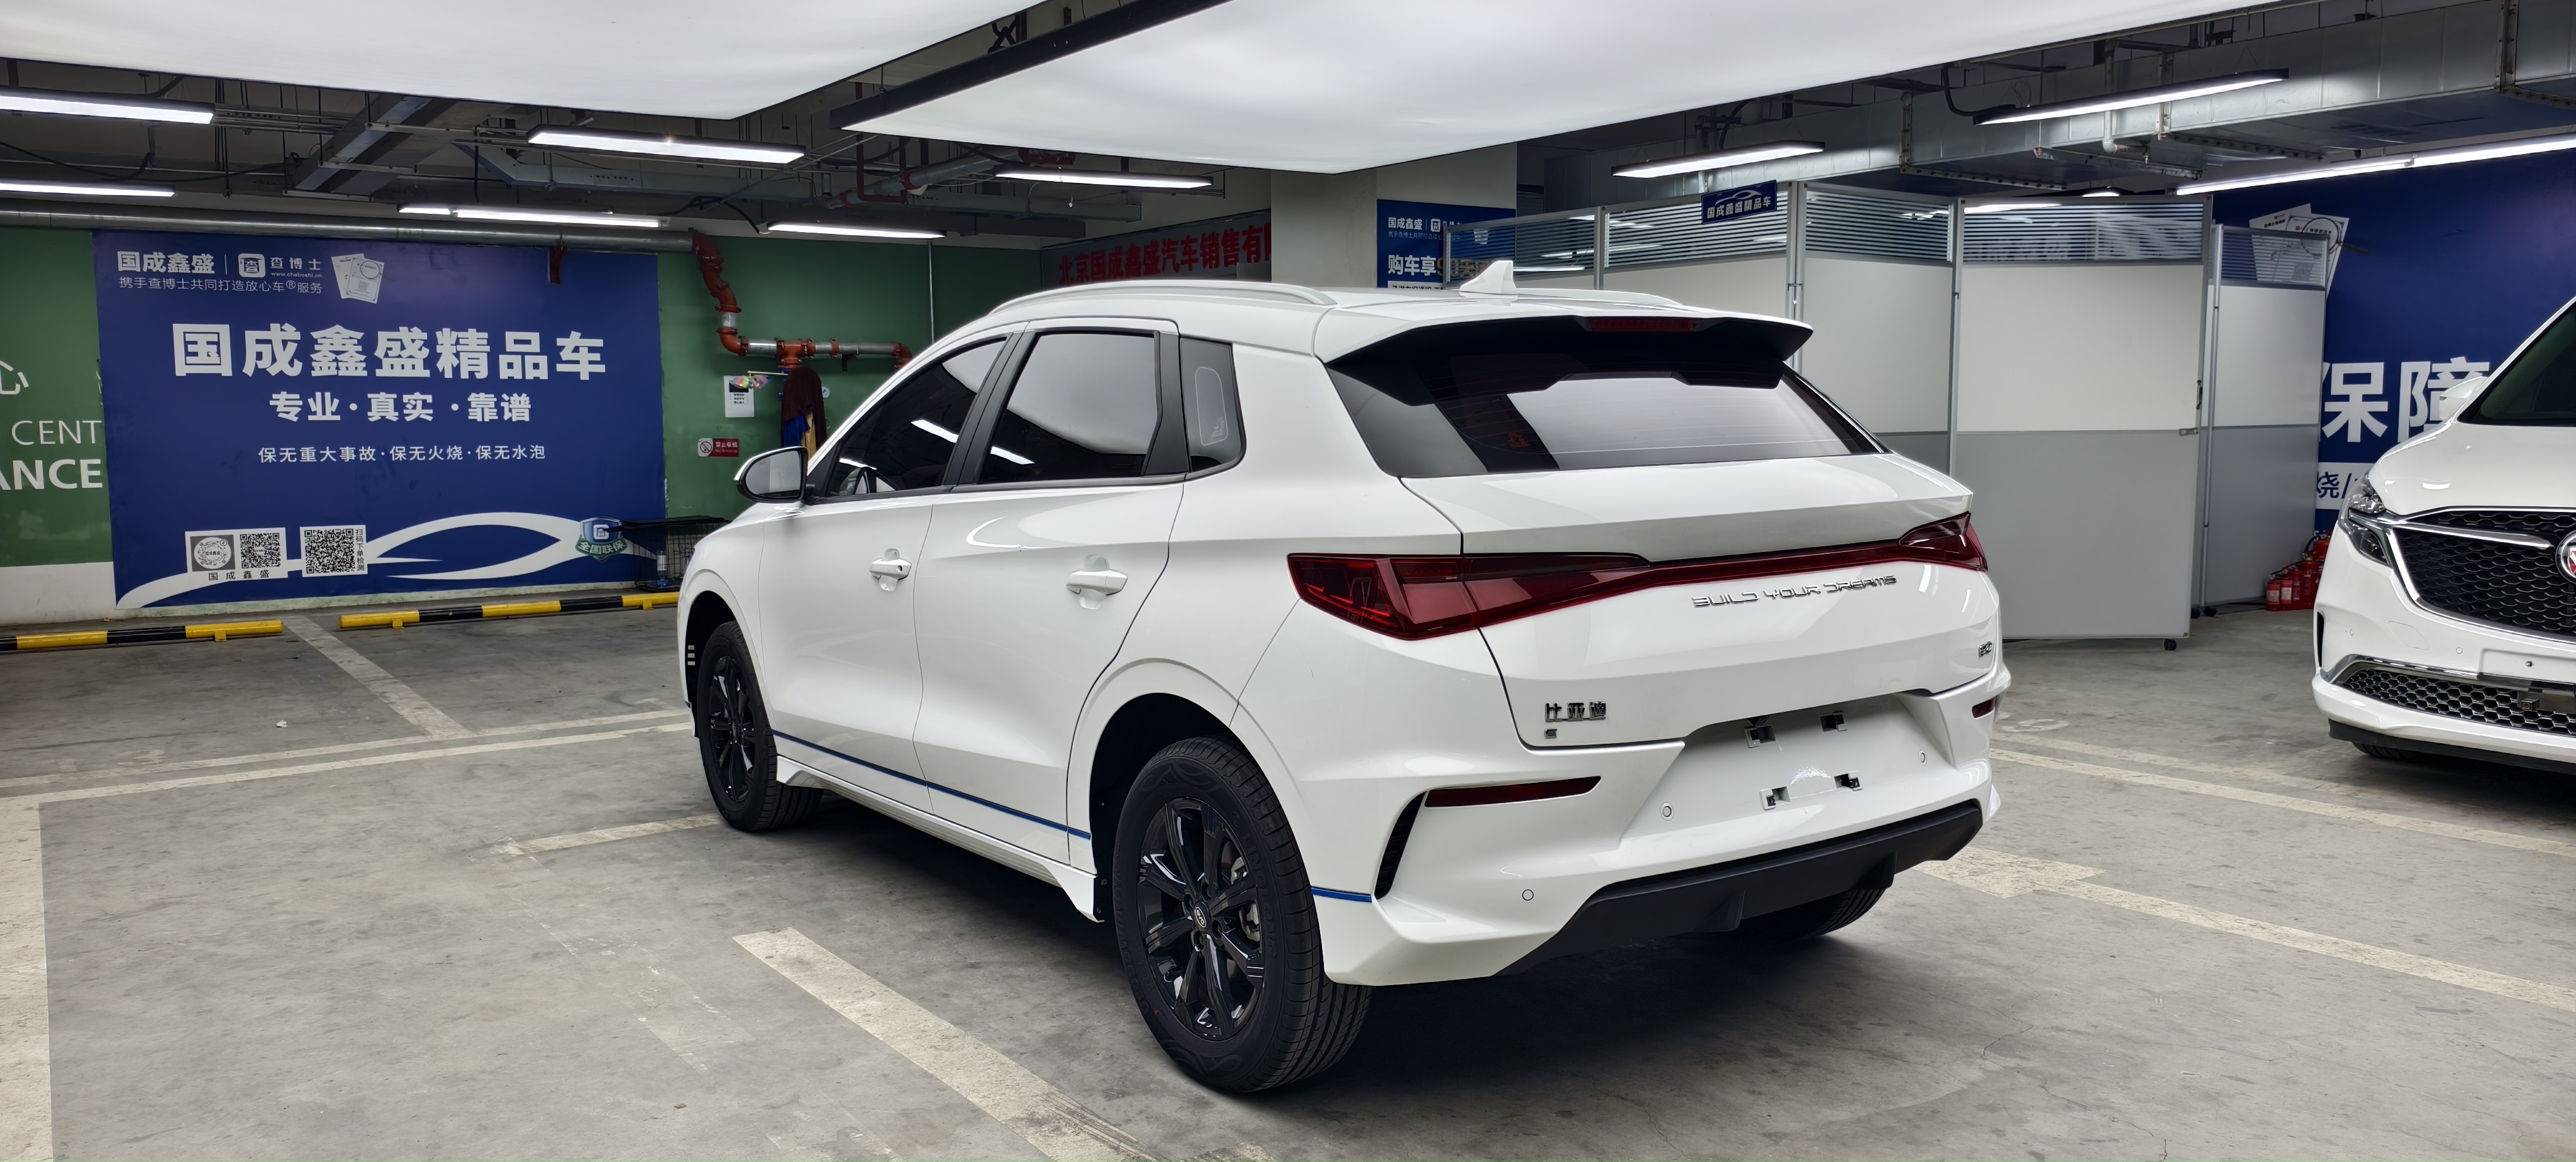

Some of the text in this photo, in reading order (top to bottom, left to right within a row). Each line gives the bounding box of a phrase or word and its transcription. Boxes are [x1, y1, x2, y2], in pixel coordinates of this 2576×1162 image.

[1388, 217, 1423, 230] 国成鑫盛
[118, 251, 214, 274] 国成鑫盛
[270, 257, 321, 271] 查博士
[1058, 223, 1272, 284] 北京国成鑫盛汽车销售有
[172, 323, 606, 380] 国成鑫盛精品车
[11, 420, 103, 445] CENT
[355, 529, 365, 572] 扫码下单检测
[577, 540, 626, 555] 全国联保
[208, 569, 270, 581] 国成鑫盛
[1692, 575, 1897, 608] BUILD YOUR DREAMS
[1545, 701, 1607, 722] 比亚迪
